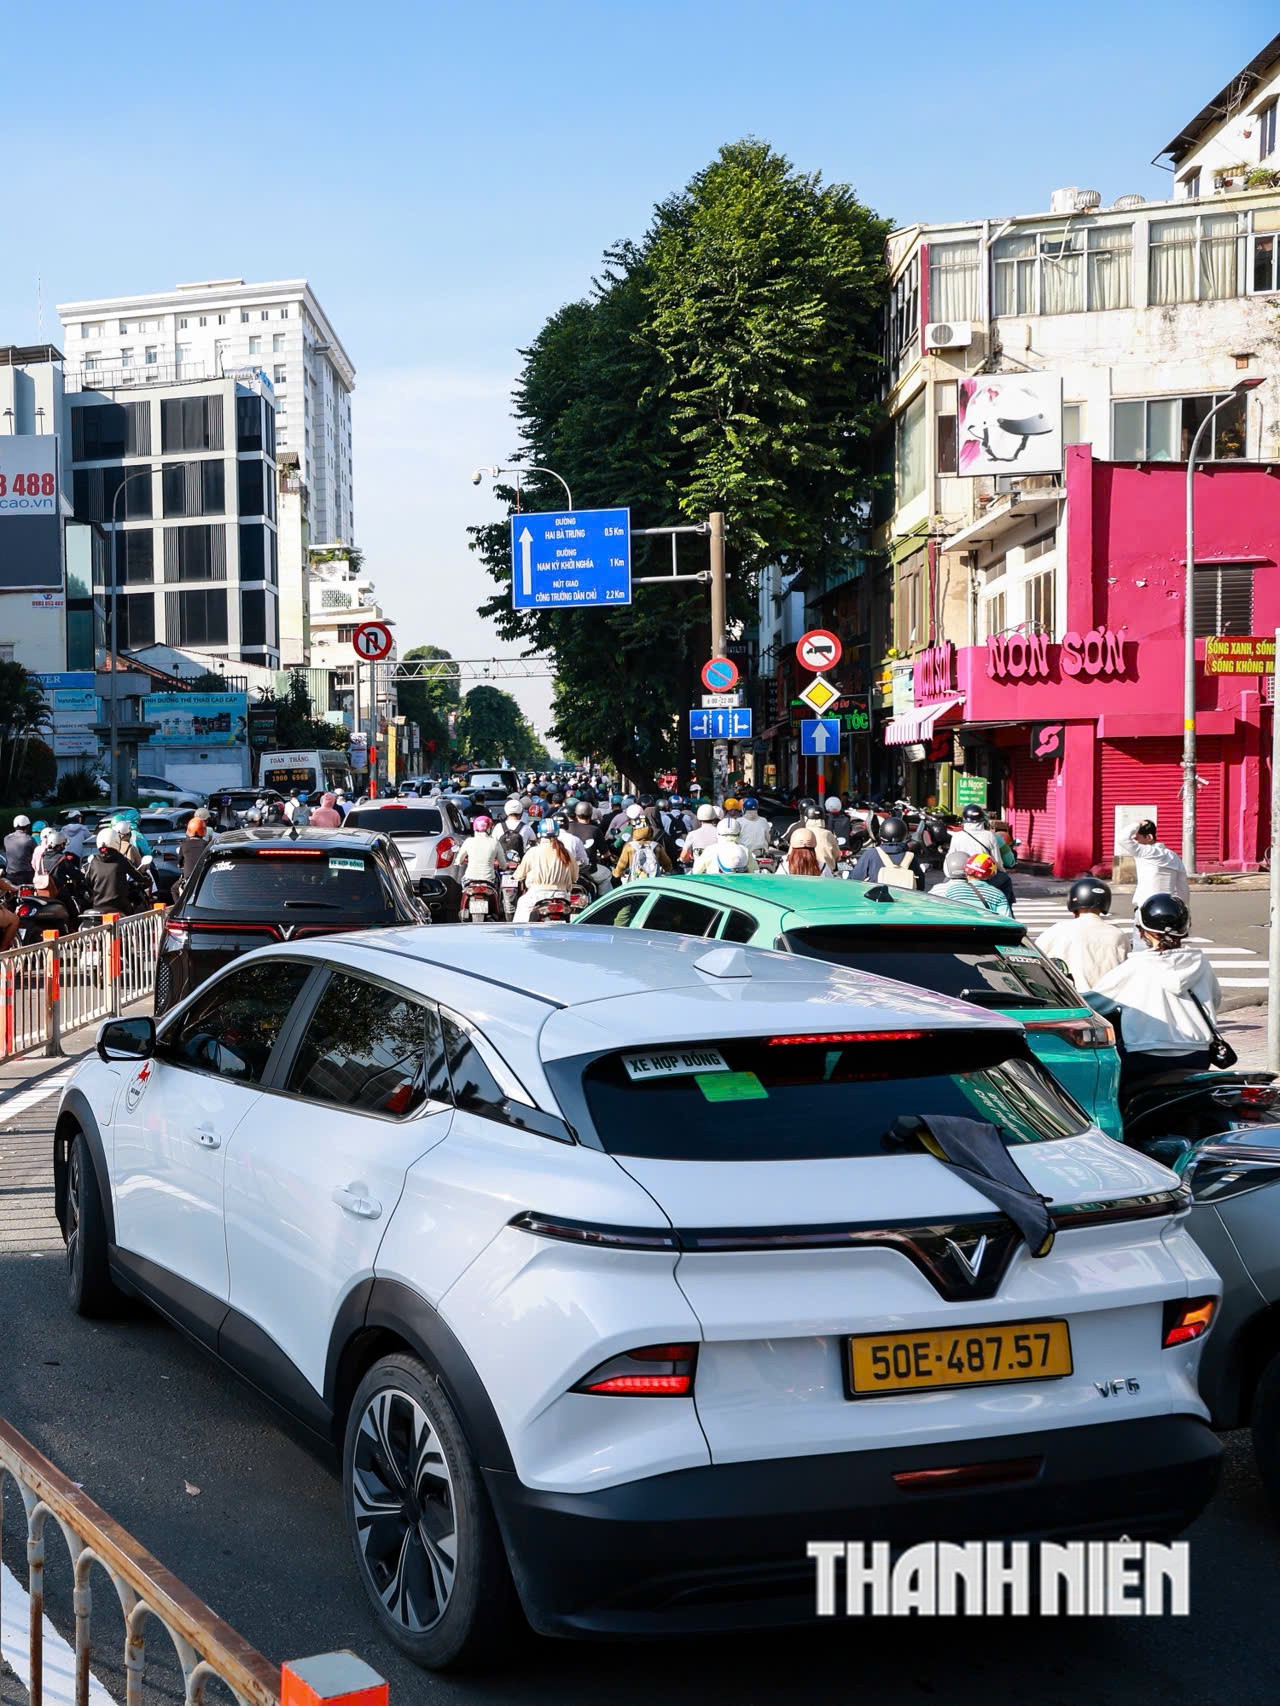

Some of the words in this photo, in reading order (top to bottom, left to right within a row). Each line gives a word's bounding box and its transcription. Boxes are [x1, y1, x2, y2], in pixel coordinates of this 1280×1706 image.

[12, 472, 55, 496] 488
[555, 516, 576, 526] ĐƯỜNG
[545, 531, 555, 540] HAI
[556, 529, 565, 539] BÀ
[604, 528, 613, 536] 0.5
[614, 528, 624, 536] Km
[556, 547, 577, 557] ĐƯỜNG
[537, 562, 551, 571] NAM
[610, 559, 613, 567] 1
[614, 558, 624, 566] Km
[606, 591, 615, 599] 2.2
[615, 590, 625, 598] Km
[1062, 626, 1126, 675] SƠN
[1207, 639, 1229, 654] SỐNG
[1231, 642, 1254, 656] XANH,
[1211, 656, 1234, 672] SỐNG
[1235, 659, 1264, 673] KHÔNG
[1265, 661, 1275, 673] M
[629, 1058, 651, 1073] XE
[649, 1055, 679, 1072] HỢP
[680, 1050, 722, 1068] ĐỒNG
